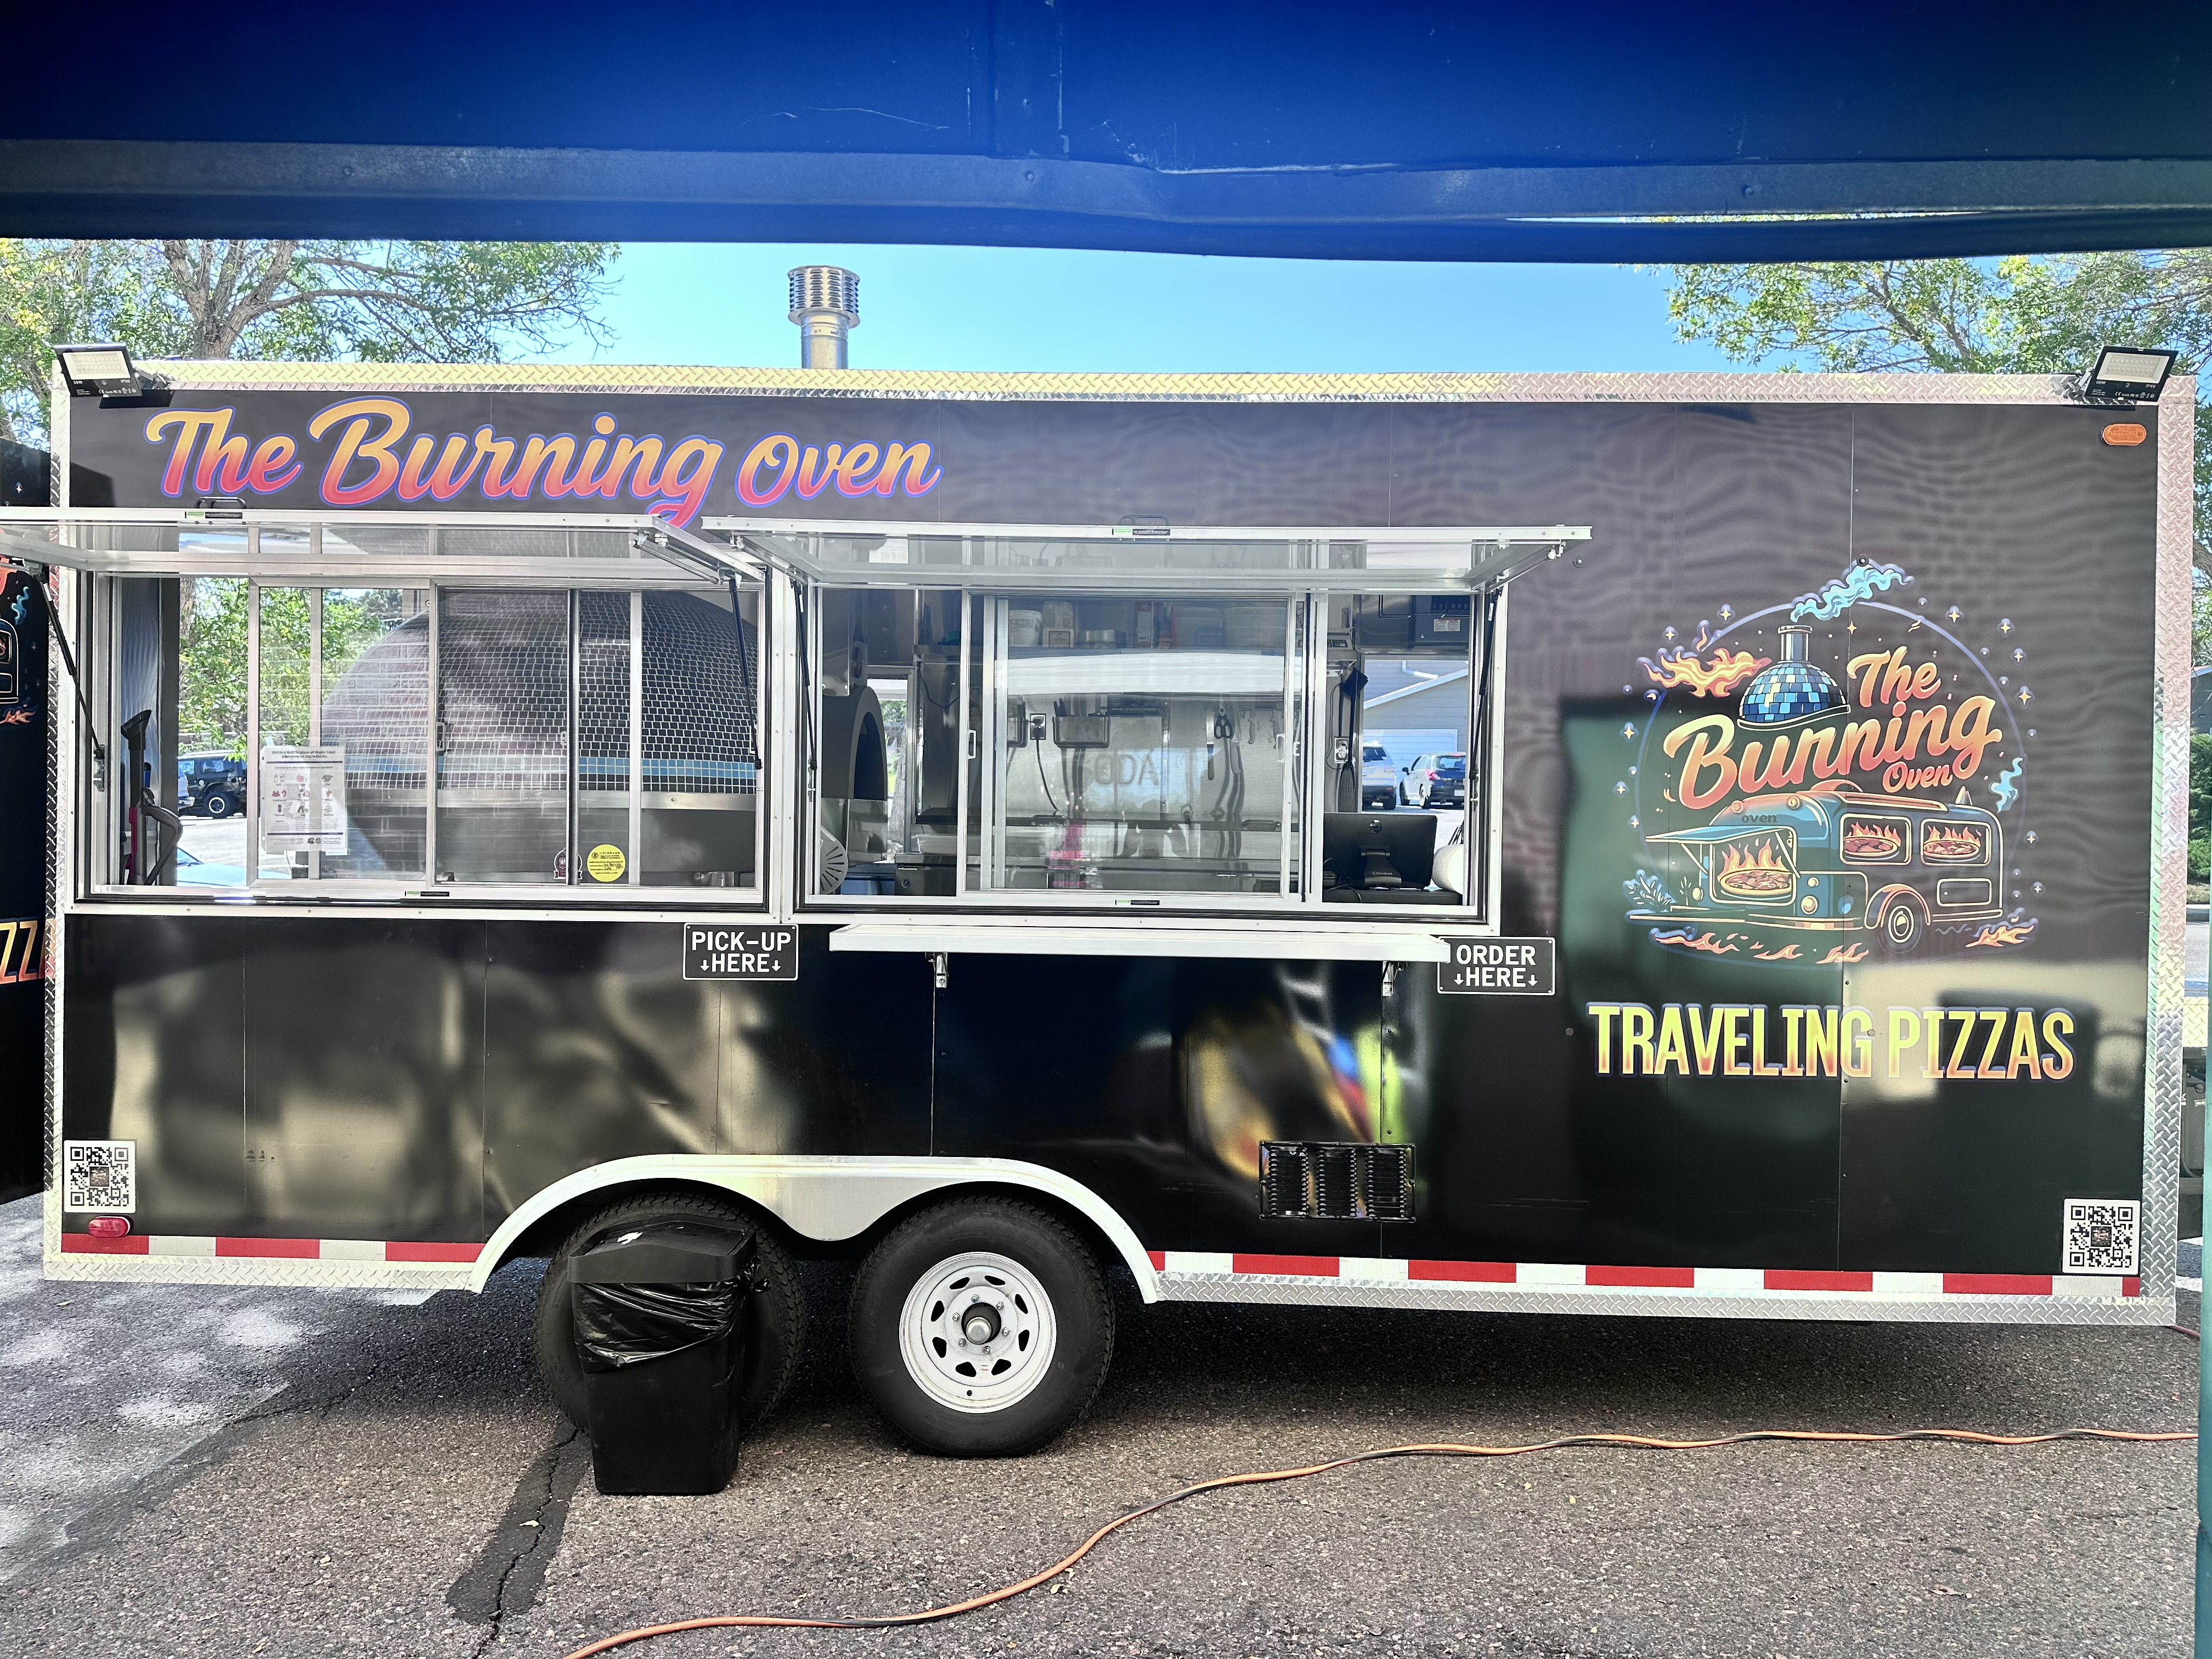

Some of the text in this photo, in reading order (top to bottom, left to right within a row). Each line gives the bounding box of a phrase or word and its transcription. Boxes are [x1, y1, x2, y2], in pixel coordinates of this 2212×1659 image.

[144, 396, 944, 527] The Burning Oven
[1846, 645, 1942, 707] The
[1663, 691, 2002, 810] Burning
[1882, 761, 1954, 793] Oven
[1741, 814, 1778, 823] oven
[692, 931, 791, 951] PICK-UP
[712, 953, 770, 973] HERE
[1456, 944, 1536, 966] ORDER
[1466, 967, 1526, 988] HERE
[1587, 1005, 2075, 1080] TRAVELING PIZZAS
